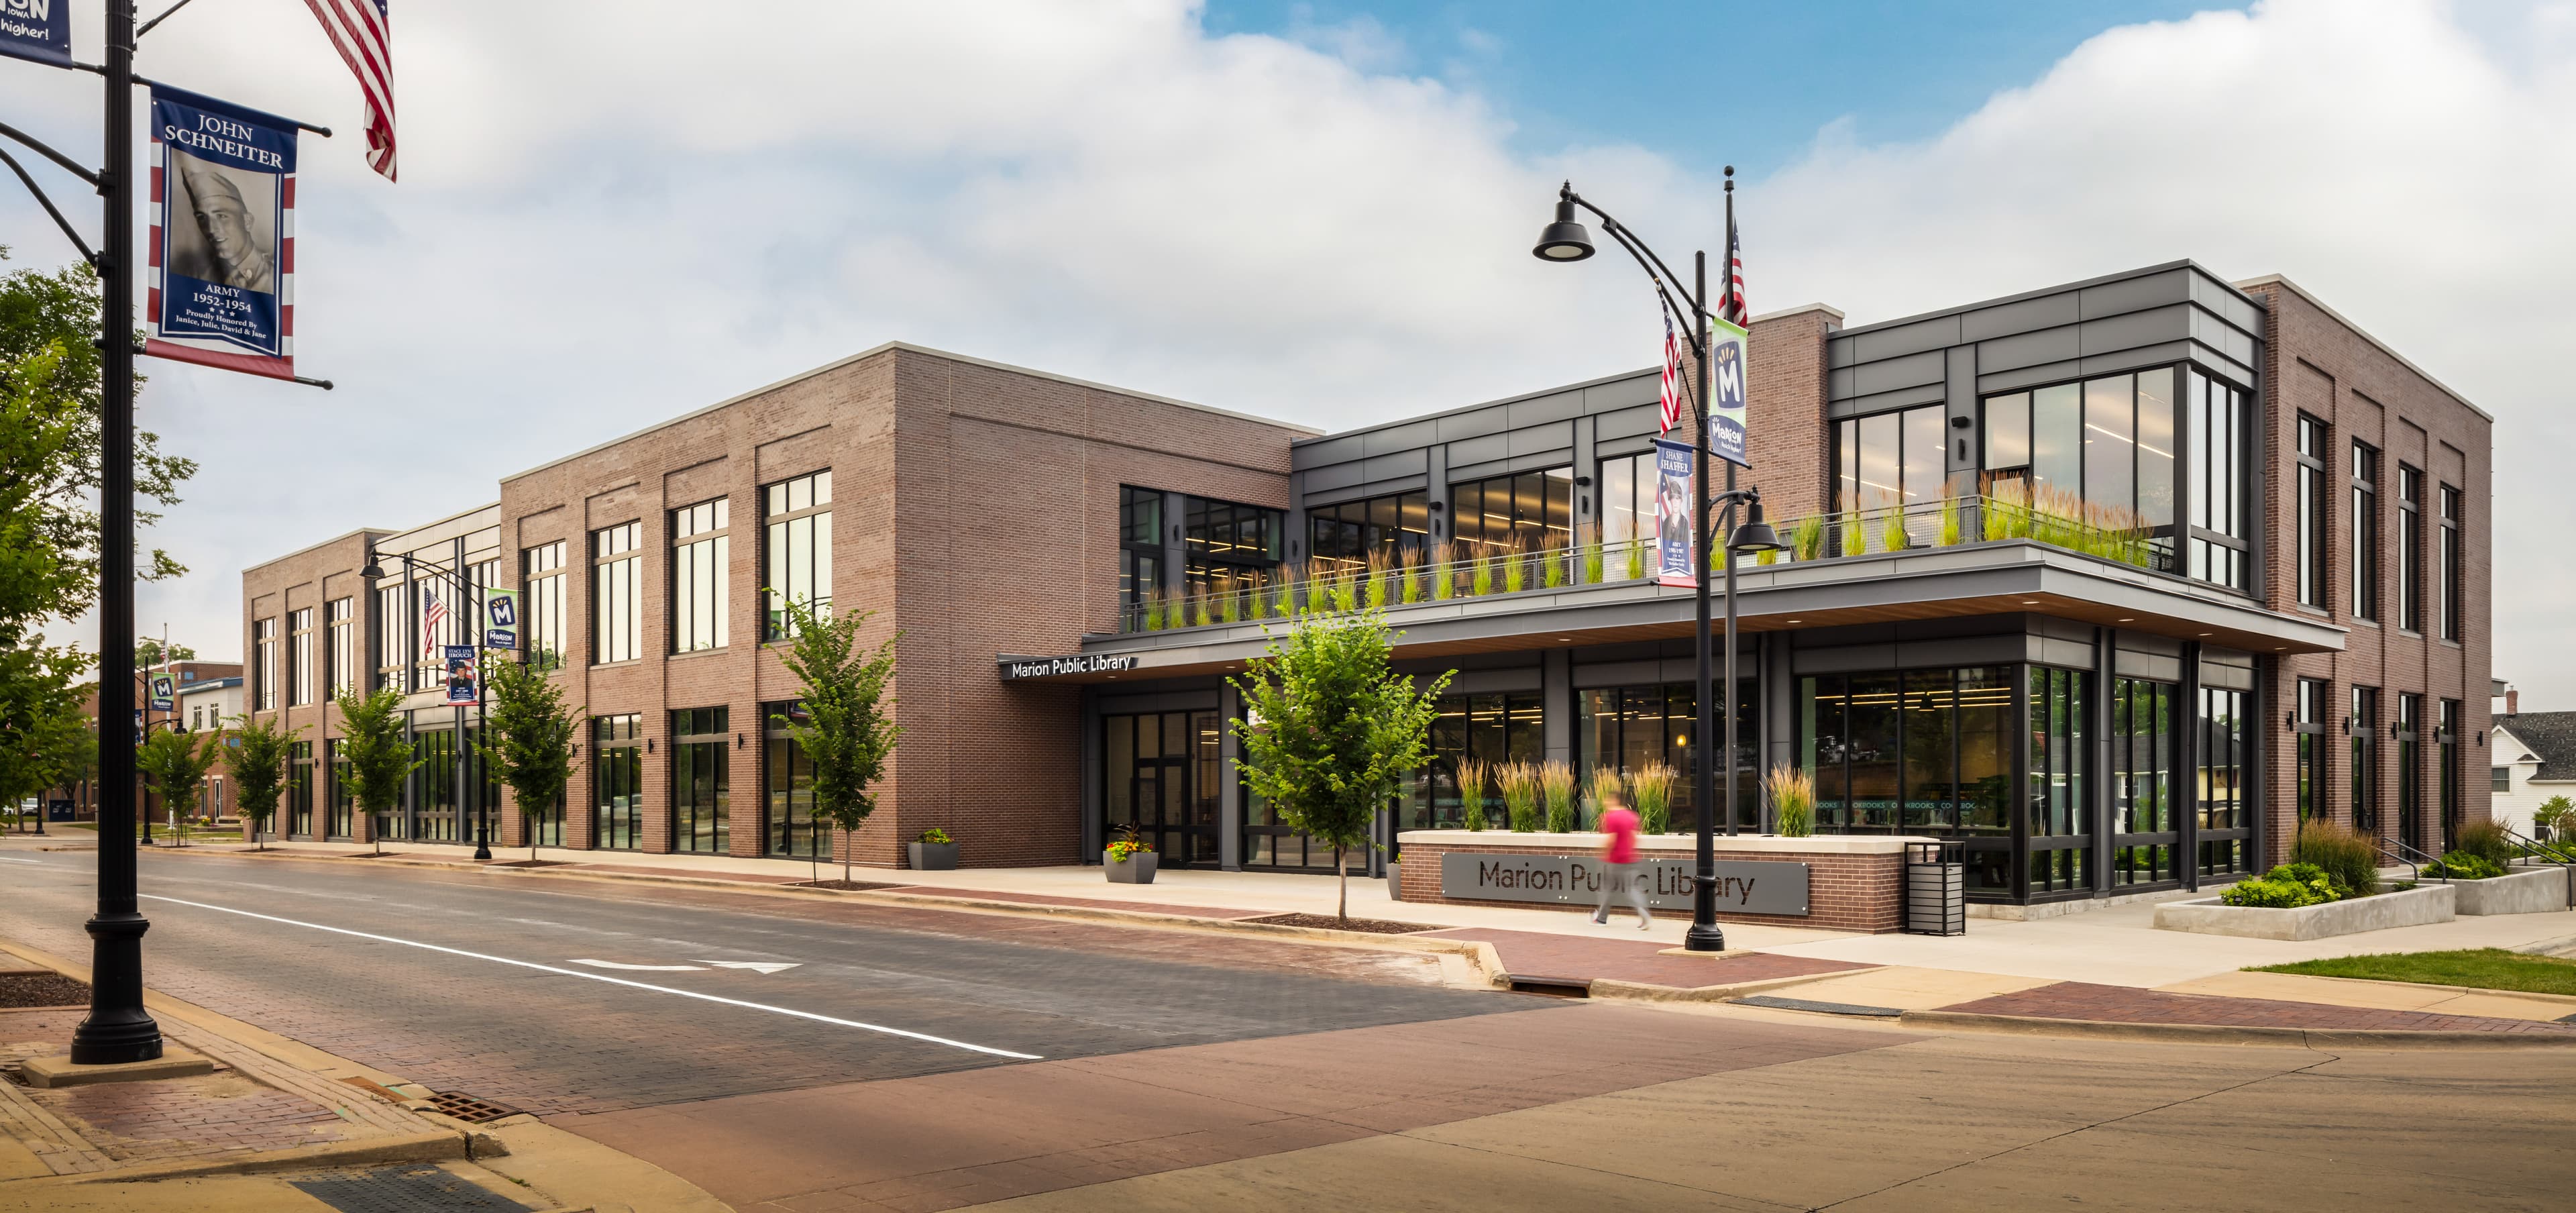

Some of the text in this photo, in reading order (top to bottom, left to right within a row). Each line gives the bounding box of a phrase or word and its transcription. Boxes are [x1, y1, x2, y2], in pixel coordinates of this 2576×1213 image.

[7, 7, 30, 19] IOWA
[1, 18, 49, 40] higher!
[198, 114, 254, 142] JOHN
[165, 125, 283, 169] SCHNEITER
[205, 284, 240, 297] ARMY
[193, 293, 252, 313] 1952-1954
[176, 315, 266, 339] Janice, Julie, David & Jane
[186, 309, 258, 330] Proudly Honored By
[1719, 360, 1740, 402] M
[1660, 459, 1688, 473] SHAFFER
[1665, 450, 1684, 462] SHANE
[494, 604, 512, 623] M
[1012, 655, 1131, 678] Marion Public Library
[158, 682, 170, 696] M
[1479, 861, 1562, 890] Marion
[1657, 867, 1756, 905] Libary
